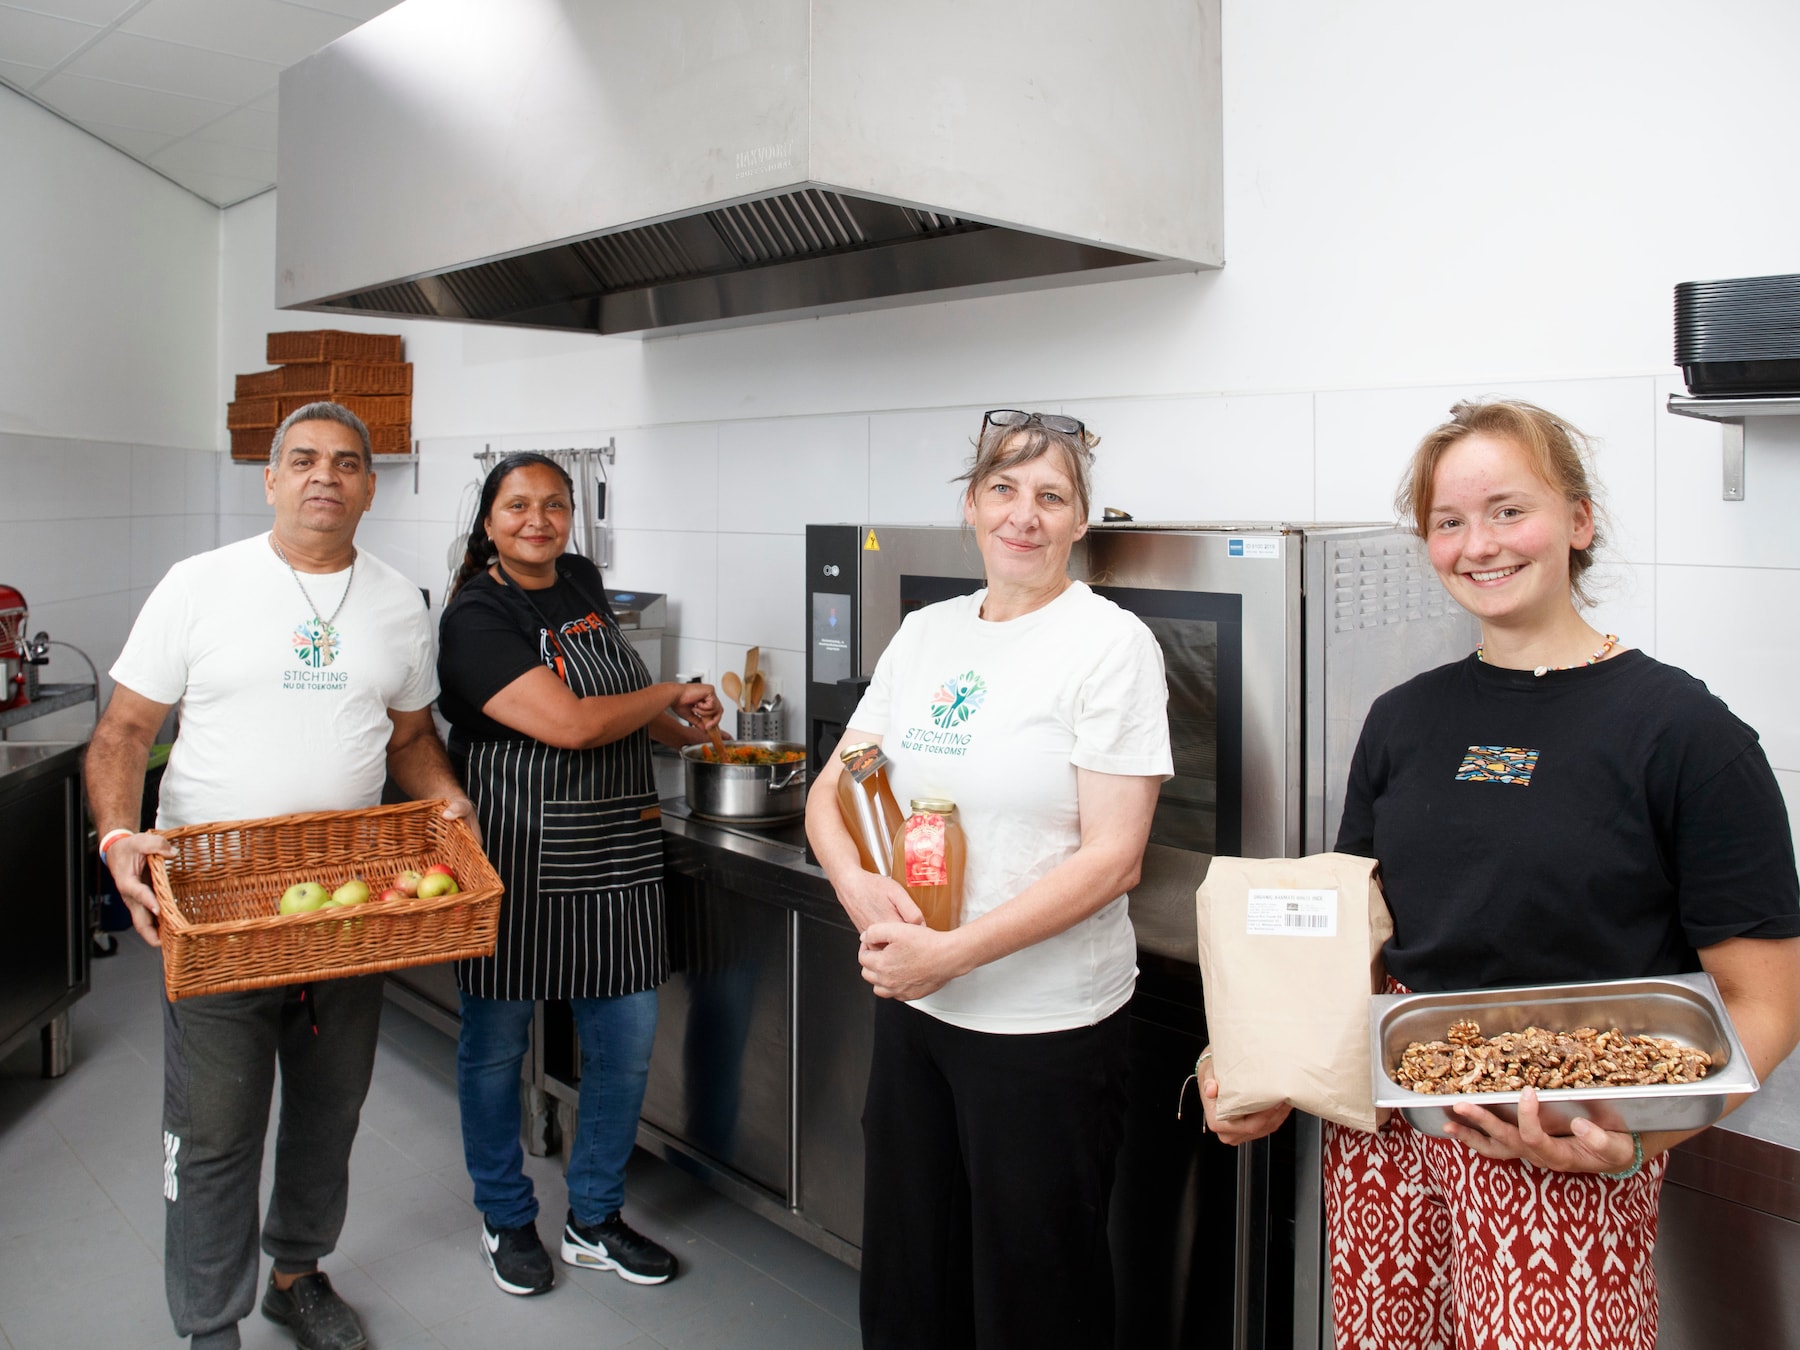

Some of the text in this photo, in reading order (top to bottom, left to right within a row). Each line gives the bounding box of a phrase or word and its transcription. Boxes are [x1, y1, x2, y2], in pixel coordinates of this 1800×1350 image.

[284, 671, 348, 682] STICHTING
[308, 683, 347, 691] TOEKOMST
[905, 728, 972, 746] STICHTING
[901, 740, 968, 756] NU DE TOEKOMST
